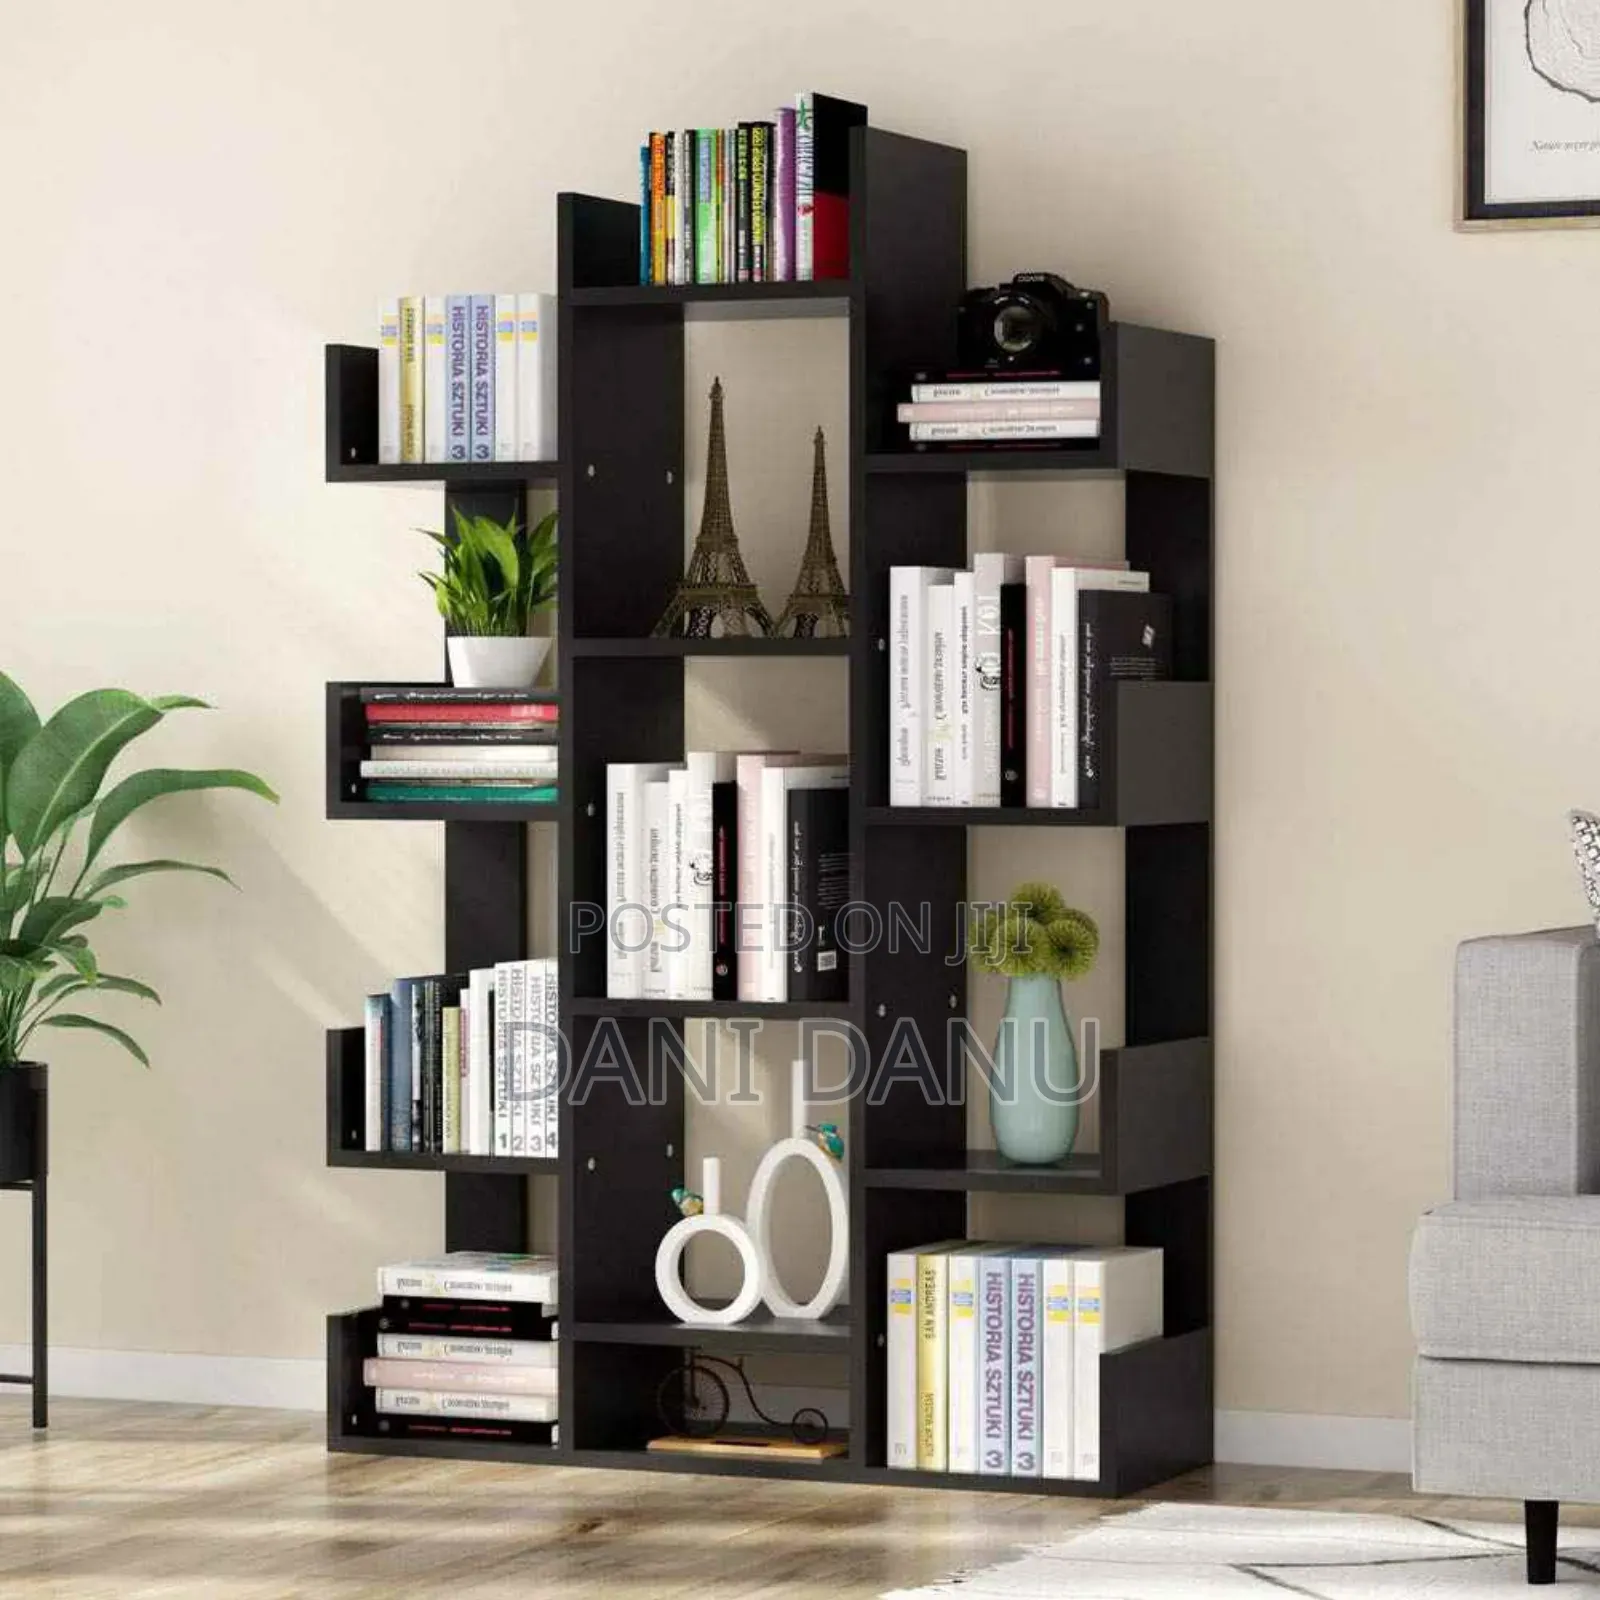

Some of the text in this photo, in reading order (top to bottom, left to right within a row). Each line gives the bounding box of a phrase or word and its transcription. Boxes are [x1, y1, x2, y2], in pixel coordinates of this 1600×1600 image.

[451, 306, 466, 460] HISTORIA SZTUKI 3
[475, 305, 489, 460] HISTORIA SZTUKI 3
[497, 1133, 509, 1150] 1
[511, 1136, 523, 1151] 2
[530, 1136, 541, 1152] 3
[545, 1132, 557, 1149] 4
[924, 1269, 936, 1339] SAN ANDREAS
[985, 1272, 1003, 1469] HISTORIA SZTUKI 3
[1017, 1273, 1035, 1471] HISTORIA SZTUKI 3
